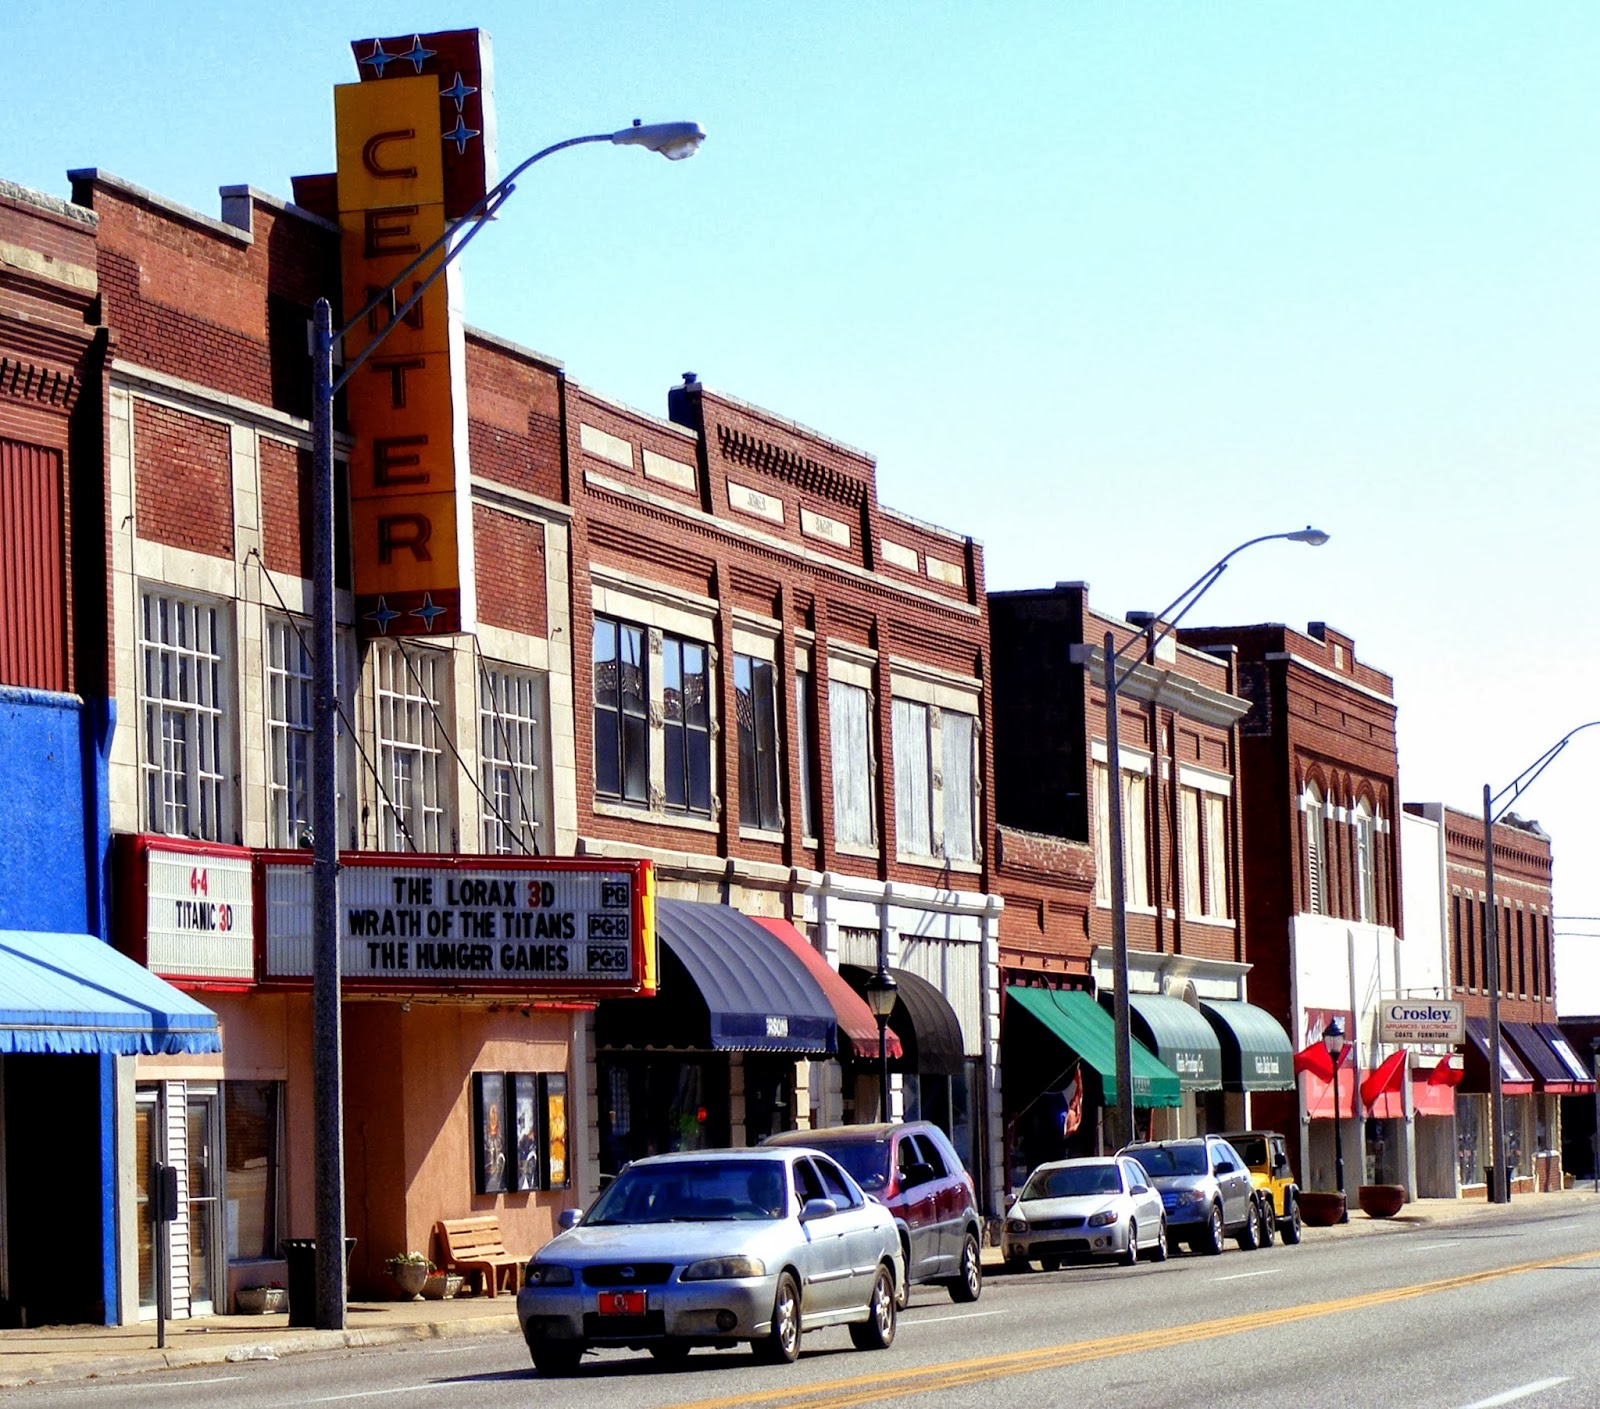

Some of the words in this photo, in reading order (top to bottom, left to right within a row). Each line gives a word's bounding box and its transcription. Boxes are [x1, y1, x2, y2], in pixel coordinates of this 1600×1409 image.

[362, 128, 433, 566] CENTER
[393, 877, 433, 905] THE
[447, 879, 517, 907] LORAX
[527, 880, 555, 908] 3D
[604, 886, 626, 905] PG
[176, 900, 216, 931] TITANIC
[218, 903, 233, 932] 3D
[349, 908, 422, 937] WRATH
[427, 909, 454, 937] OF
[460, 910, 496, 938] THE
[502, 911, 576, 940] TITANS
[590, 917, 626, 937] PG-13
[367, 941, 409, 970] THE
[416, 942, 494, 971] HUNGER
[500, 943, 570, 972] GAMES
[589, 949, 625, 969] PG-13
[1391, 1005, 1452, 1024] Crosley
[1394, 1031, 1413, 1039] COATS
[1417, 1031, 1449, 1039] FURNITURE
